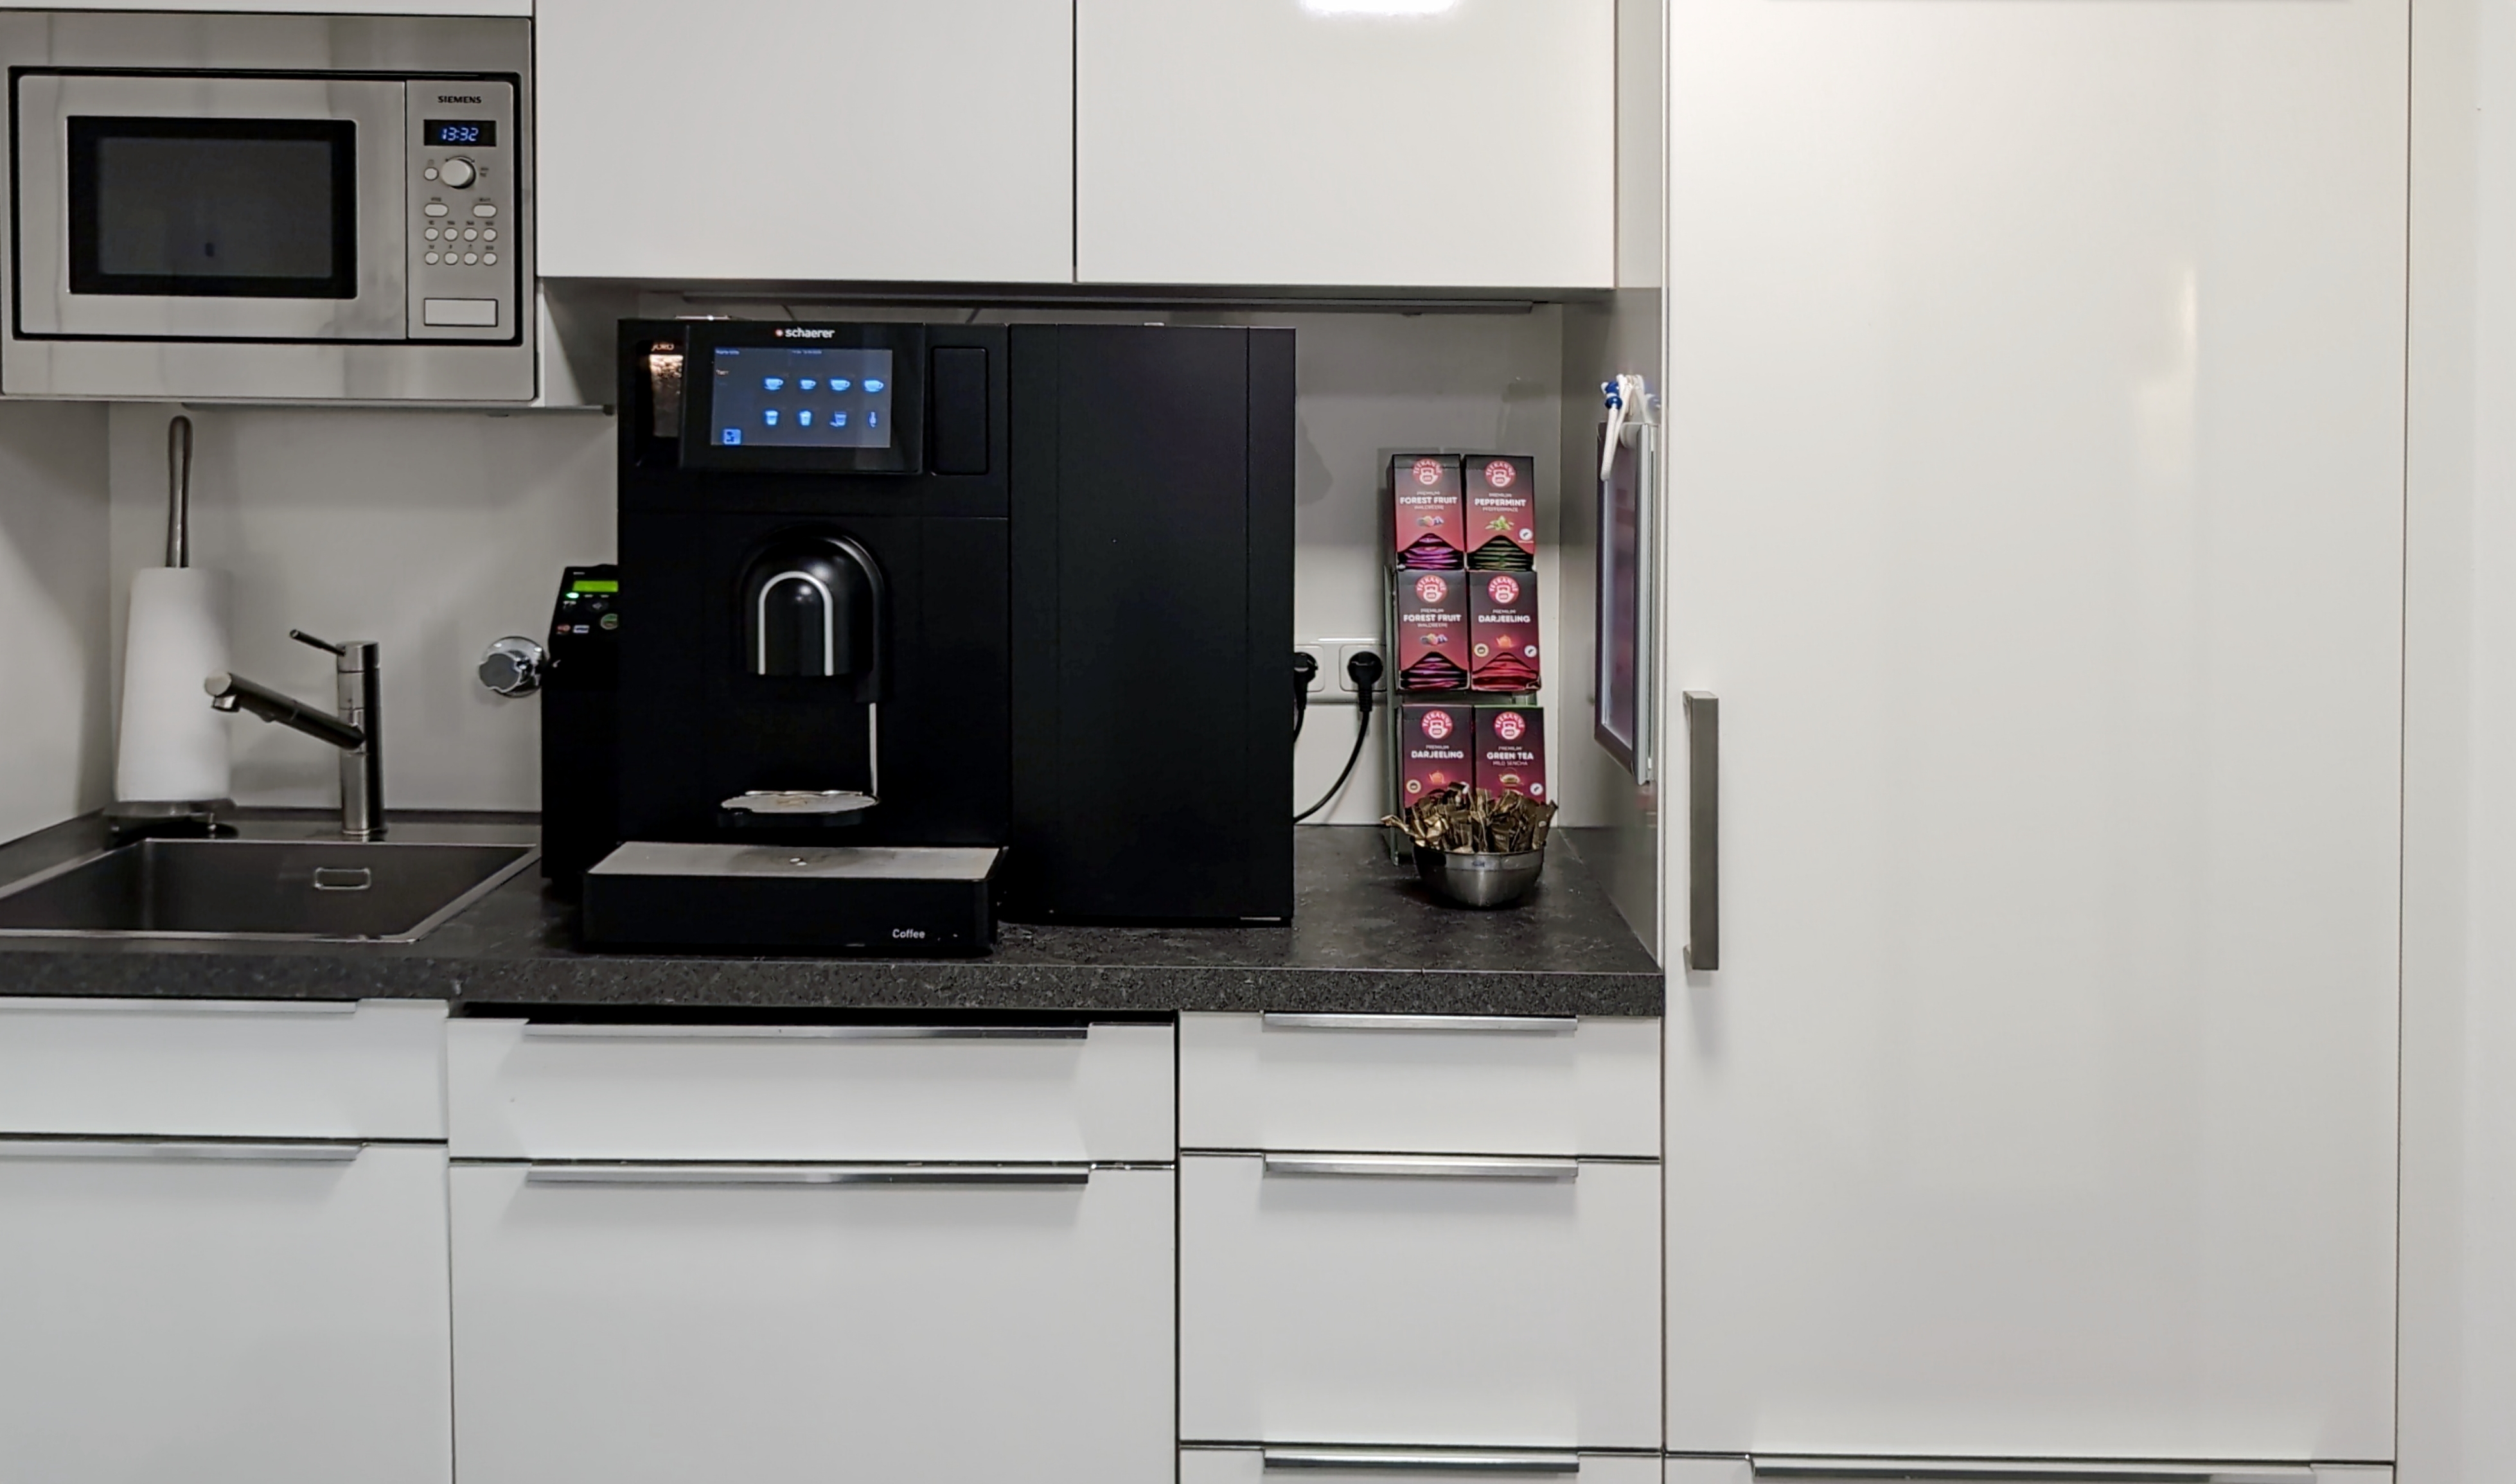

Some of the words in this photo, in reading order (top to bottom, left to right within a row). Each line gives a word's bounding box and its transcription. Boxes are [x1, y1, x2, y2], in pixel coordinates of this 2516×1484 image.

[442, 127, 479, 141] 13:32
[784, 326, 835, 338] schaerer
[1475, 499, 1527, 507] PEPPERMINT
[1478, 615, 1530, 623] DARJEELING
[1411, 750, 1464, 759] DARJEELING
[892, 928, 926, 939] Coffee
